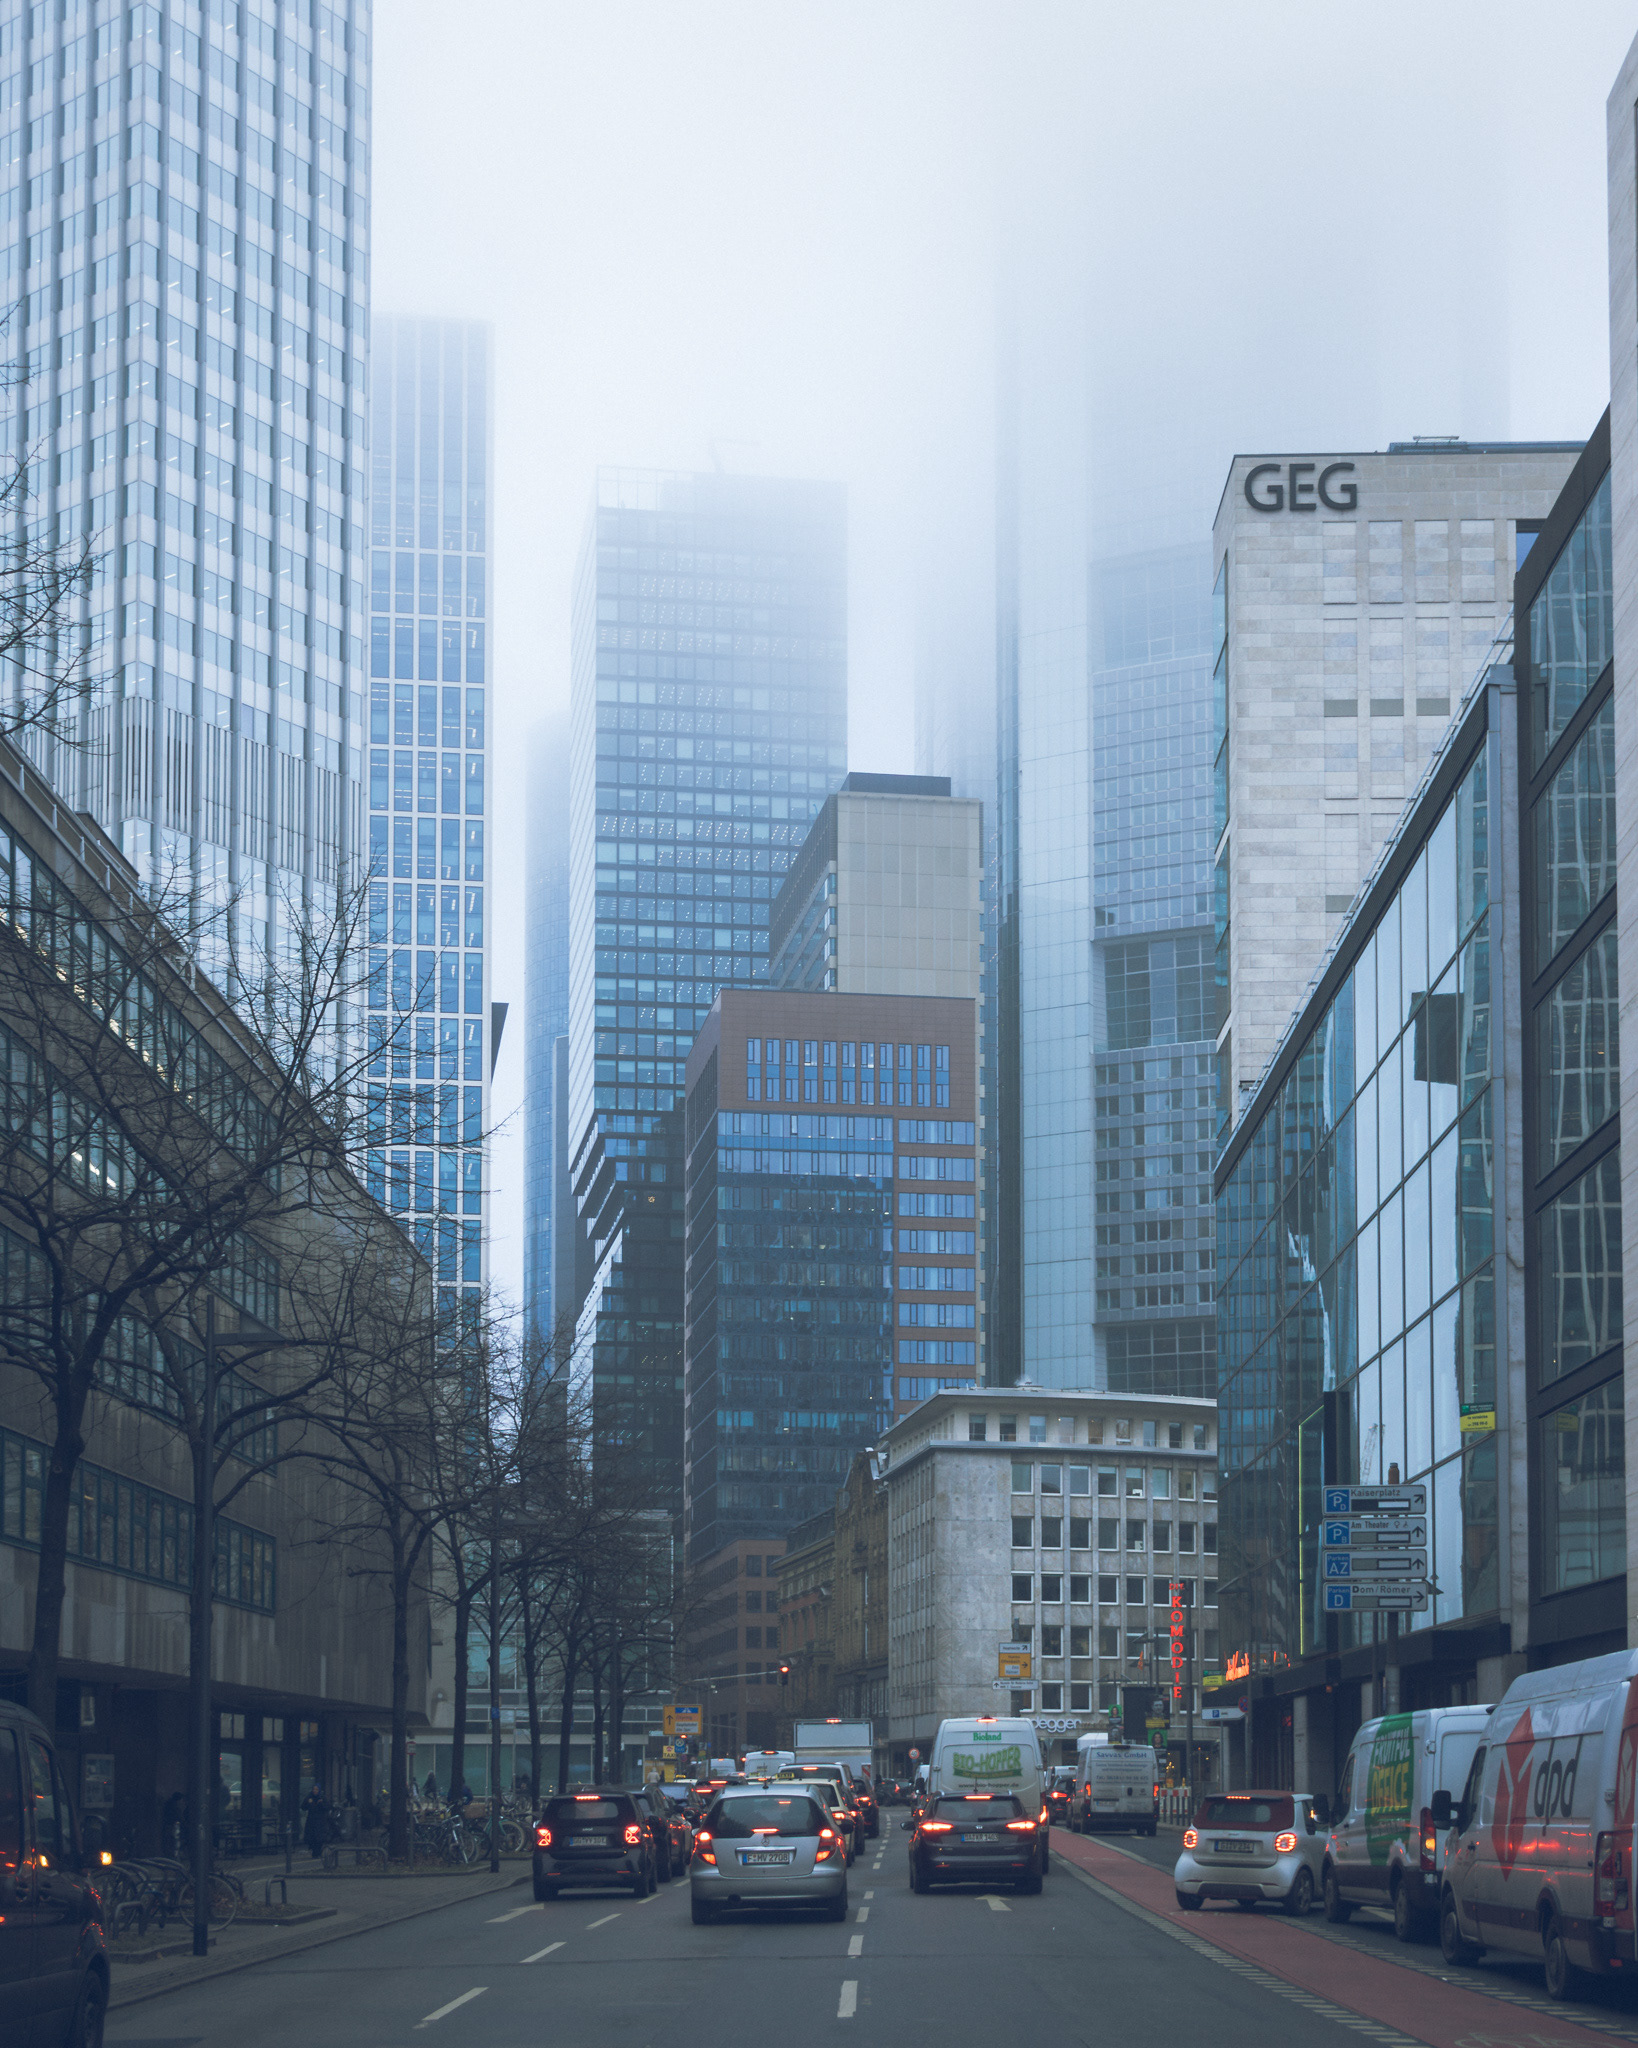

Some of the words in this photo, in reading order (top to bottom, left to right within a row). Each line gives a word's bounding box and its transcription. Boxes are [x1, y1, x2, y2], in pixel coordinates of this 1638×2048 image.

[1244, 462, 1357, 511] GEG
[1350, 1488, 1401, 1498] Kaiserplatz
[1351, 1521, 1362, 1529] Am
[1365, 1520, 1389, 1529] Theater
[1329, 1562, 1348, 1574] AZ
[1334, 1594, 1344, 1607] D
[973, 1732, 1002, 1741] Bioland
[1372, 1726, 1411, 1768] FRUITFUL
[953, 1745, 1021, 1772] BIO-HOPPER
[1371, 1761, 1409, 1816] OFFICE
[1534, 1733, 1584, 1837] dpd
